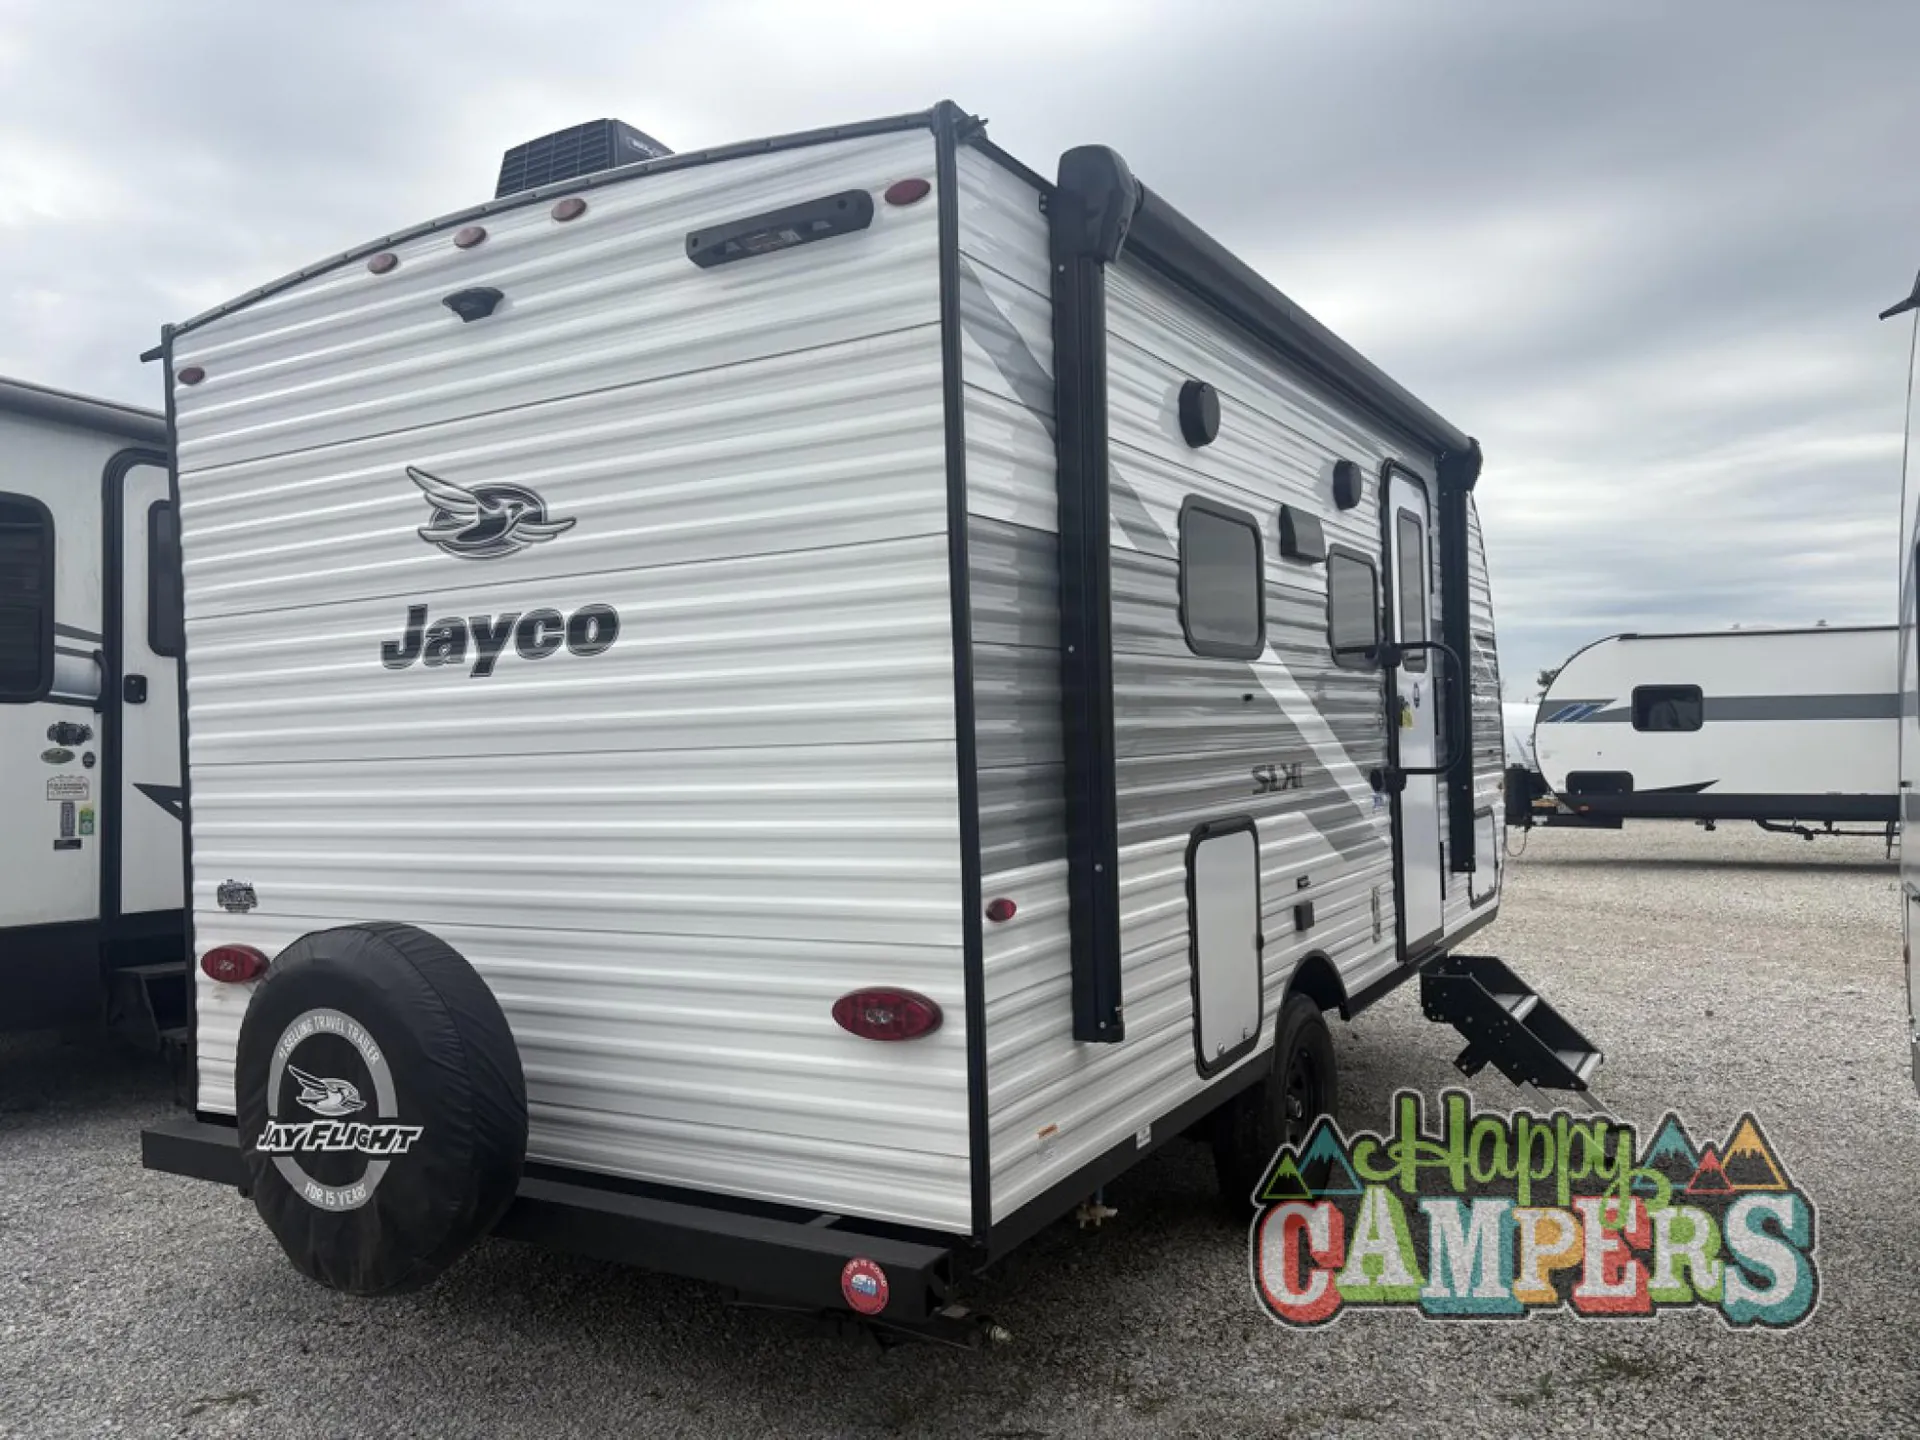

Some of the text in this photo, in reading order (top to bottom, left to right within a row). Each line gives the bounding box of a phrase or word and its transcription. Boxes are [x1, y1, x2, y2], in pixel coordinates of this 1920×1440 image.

[380, 603, 620, 678] Jayco
[313, 1015, 345, 1033] TRAVEL
[348, 1023, 381, 1065] TRAILER
[305, 1182, 366, 1206] FOR 15 YEARS
